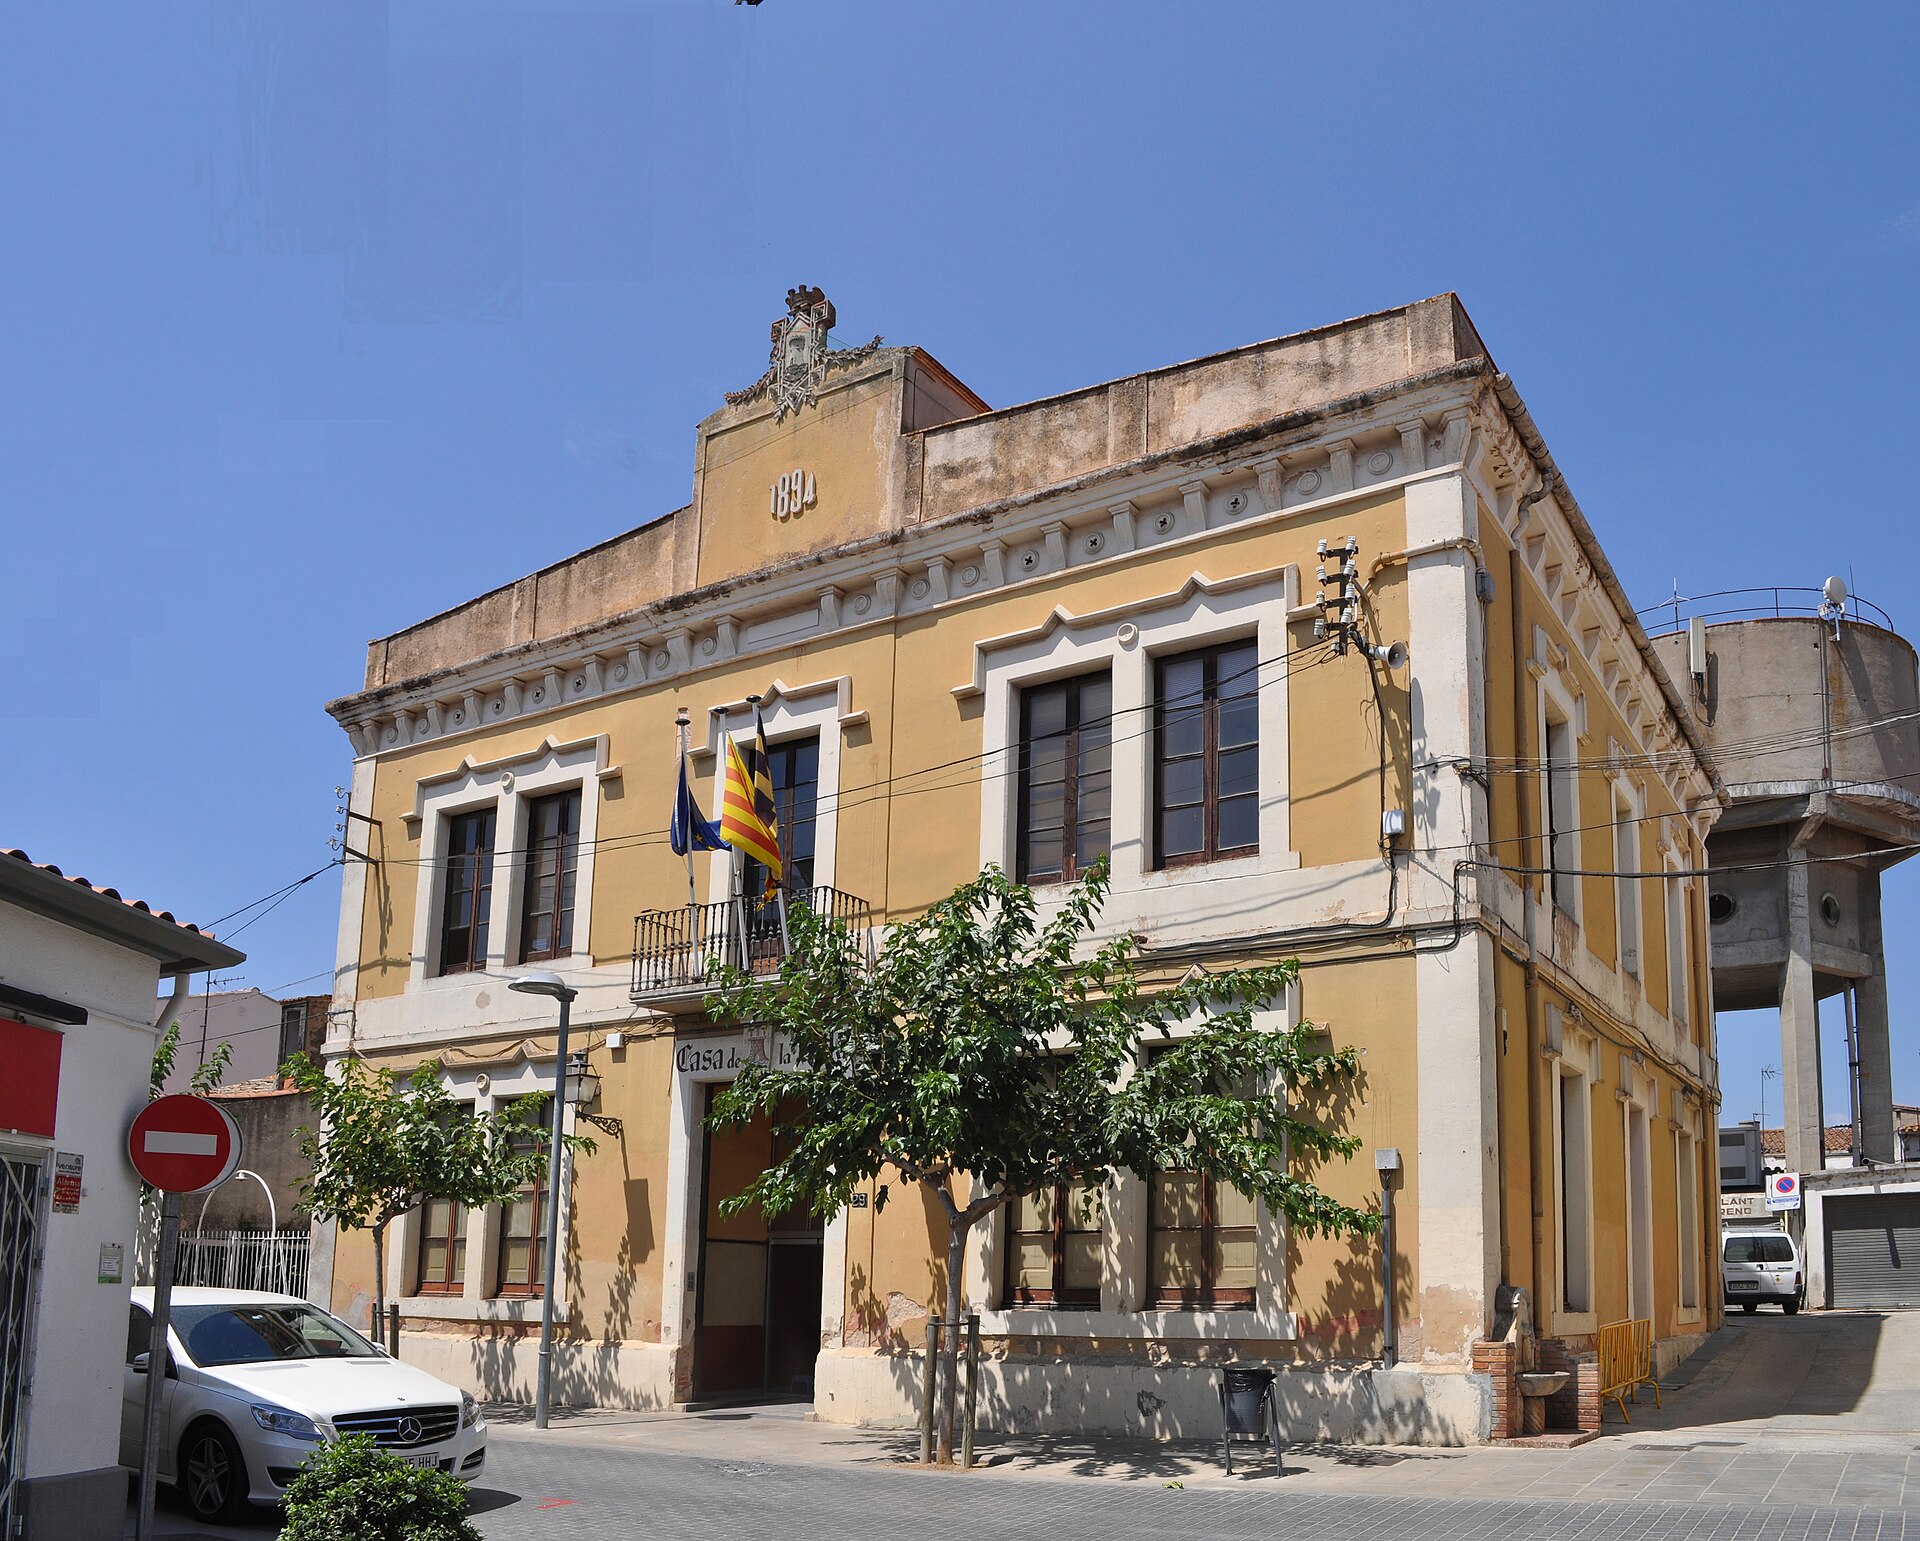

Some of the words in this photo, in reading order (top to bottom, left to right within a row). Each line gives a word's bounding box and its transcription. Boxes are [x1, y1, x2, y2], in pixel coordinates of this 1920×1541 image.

[769, 468, 817, 518] 1894
[676, 1043, 724, 1073] Casa
[727, 1047, 741, 1069] de
[779, 1042, 791, 1065] la
[852, 1194, 866, 1206] 29
[418, 1455, 438, 1468] HHJ
